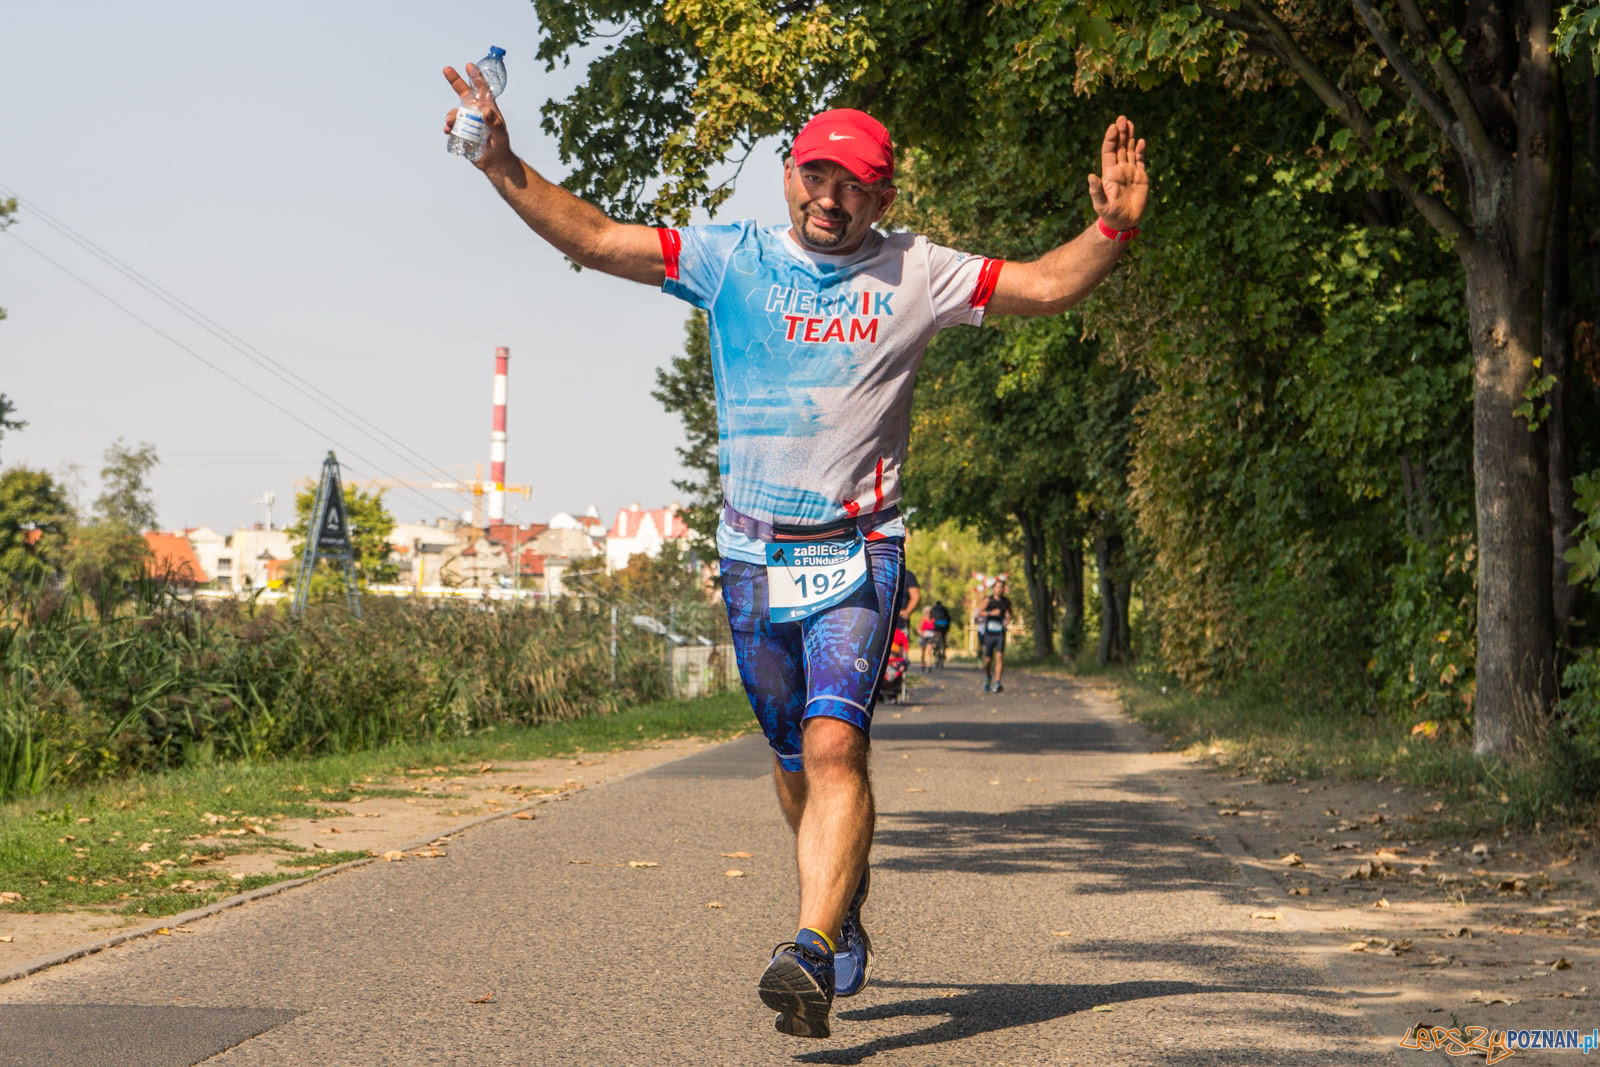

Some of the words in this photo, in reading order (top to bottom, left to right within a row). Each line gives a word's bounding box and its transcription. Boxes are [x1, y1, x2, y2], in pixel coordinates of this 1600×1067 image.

[765, 284, 894, 316] HERNIK
[784, 315, 879, 344] TEAM
[794, 568, 846, 598] 192
